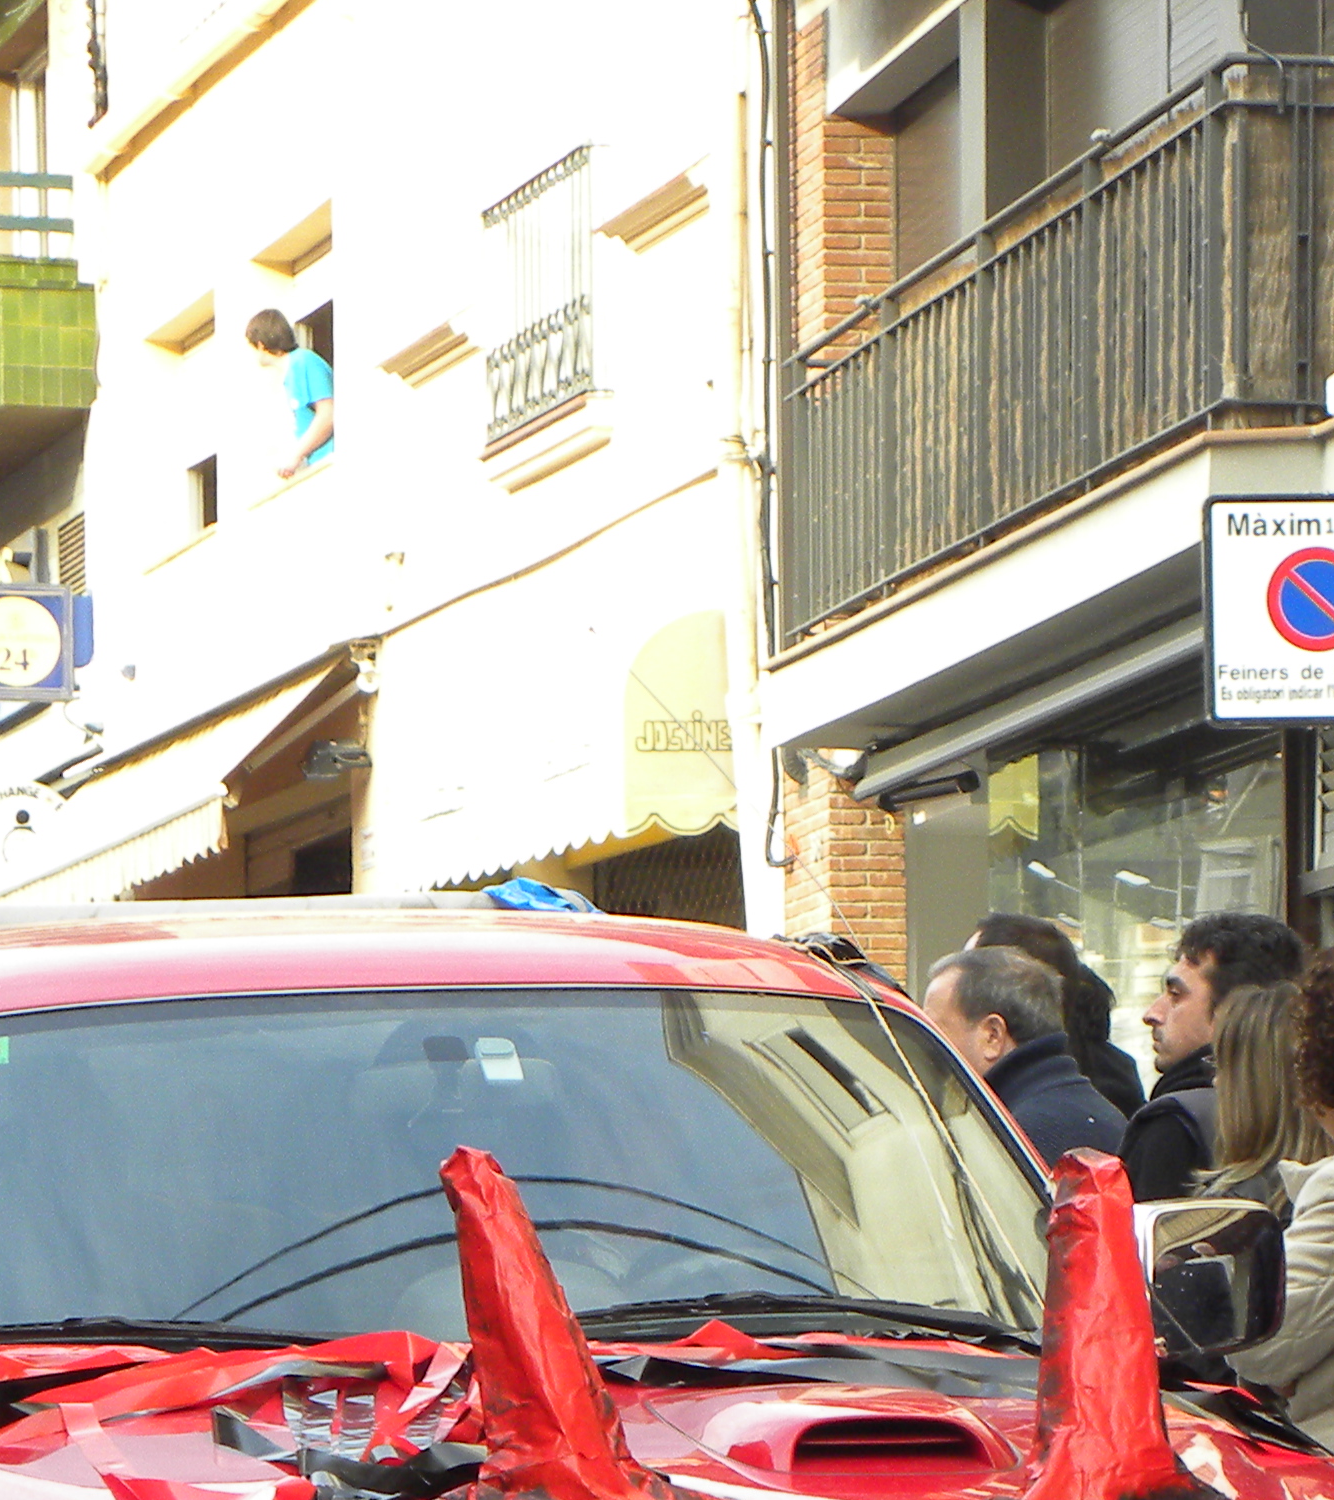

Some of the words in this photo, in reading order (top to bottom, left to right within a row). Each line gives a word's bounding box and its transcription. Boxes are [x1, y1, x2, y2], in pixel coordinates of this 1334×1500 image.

[1227, 512, 1321, 537] Màxim
[1218, 664, 1289, 680] Feiners
[1300, 664, 1324, 680] de
[1289, 685, 1324, 700] indicar
